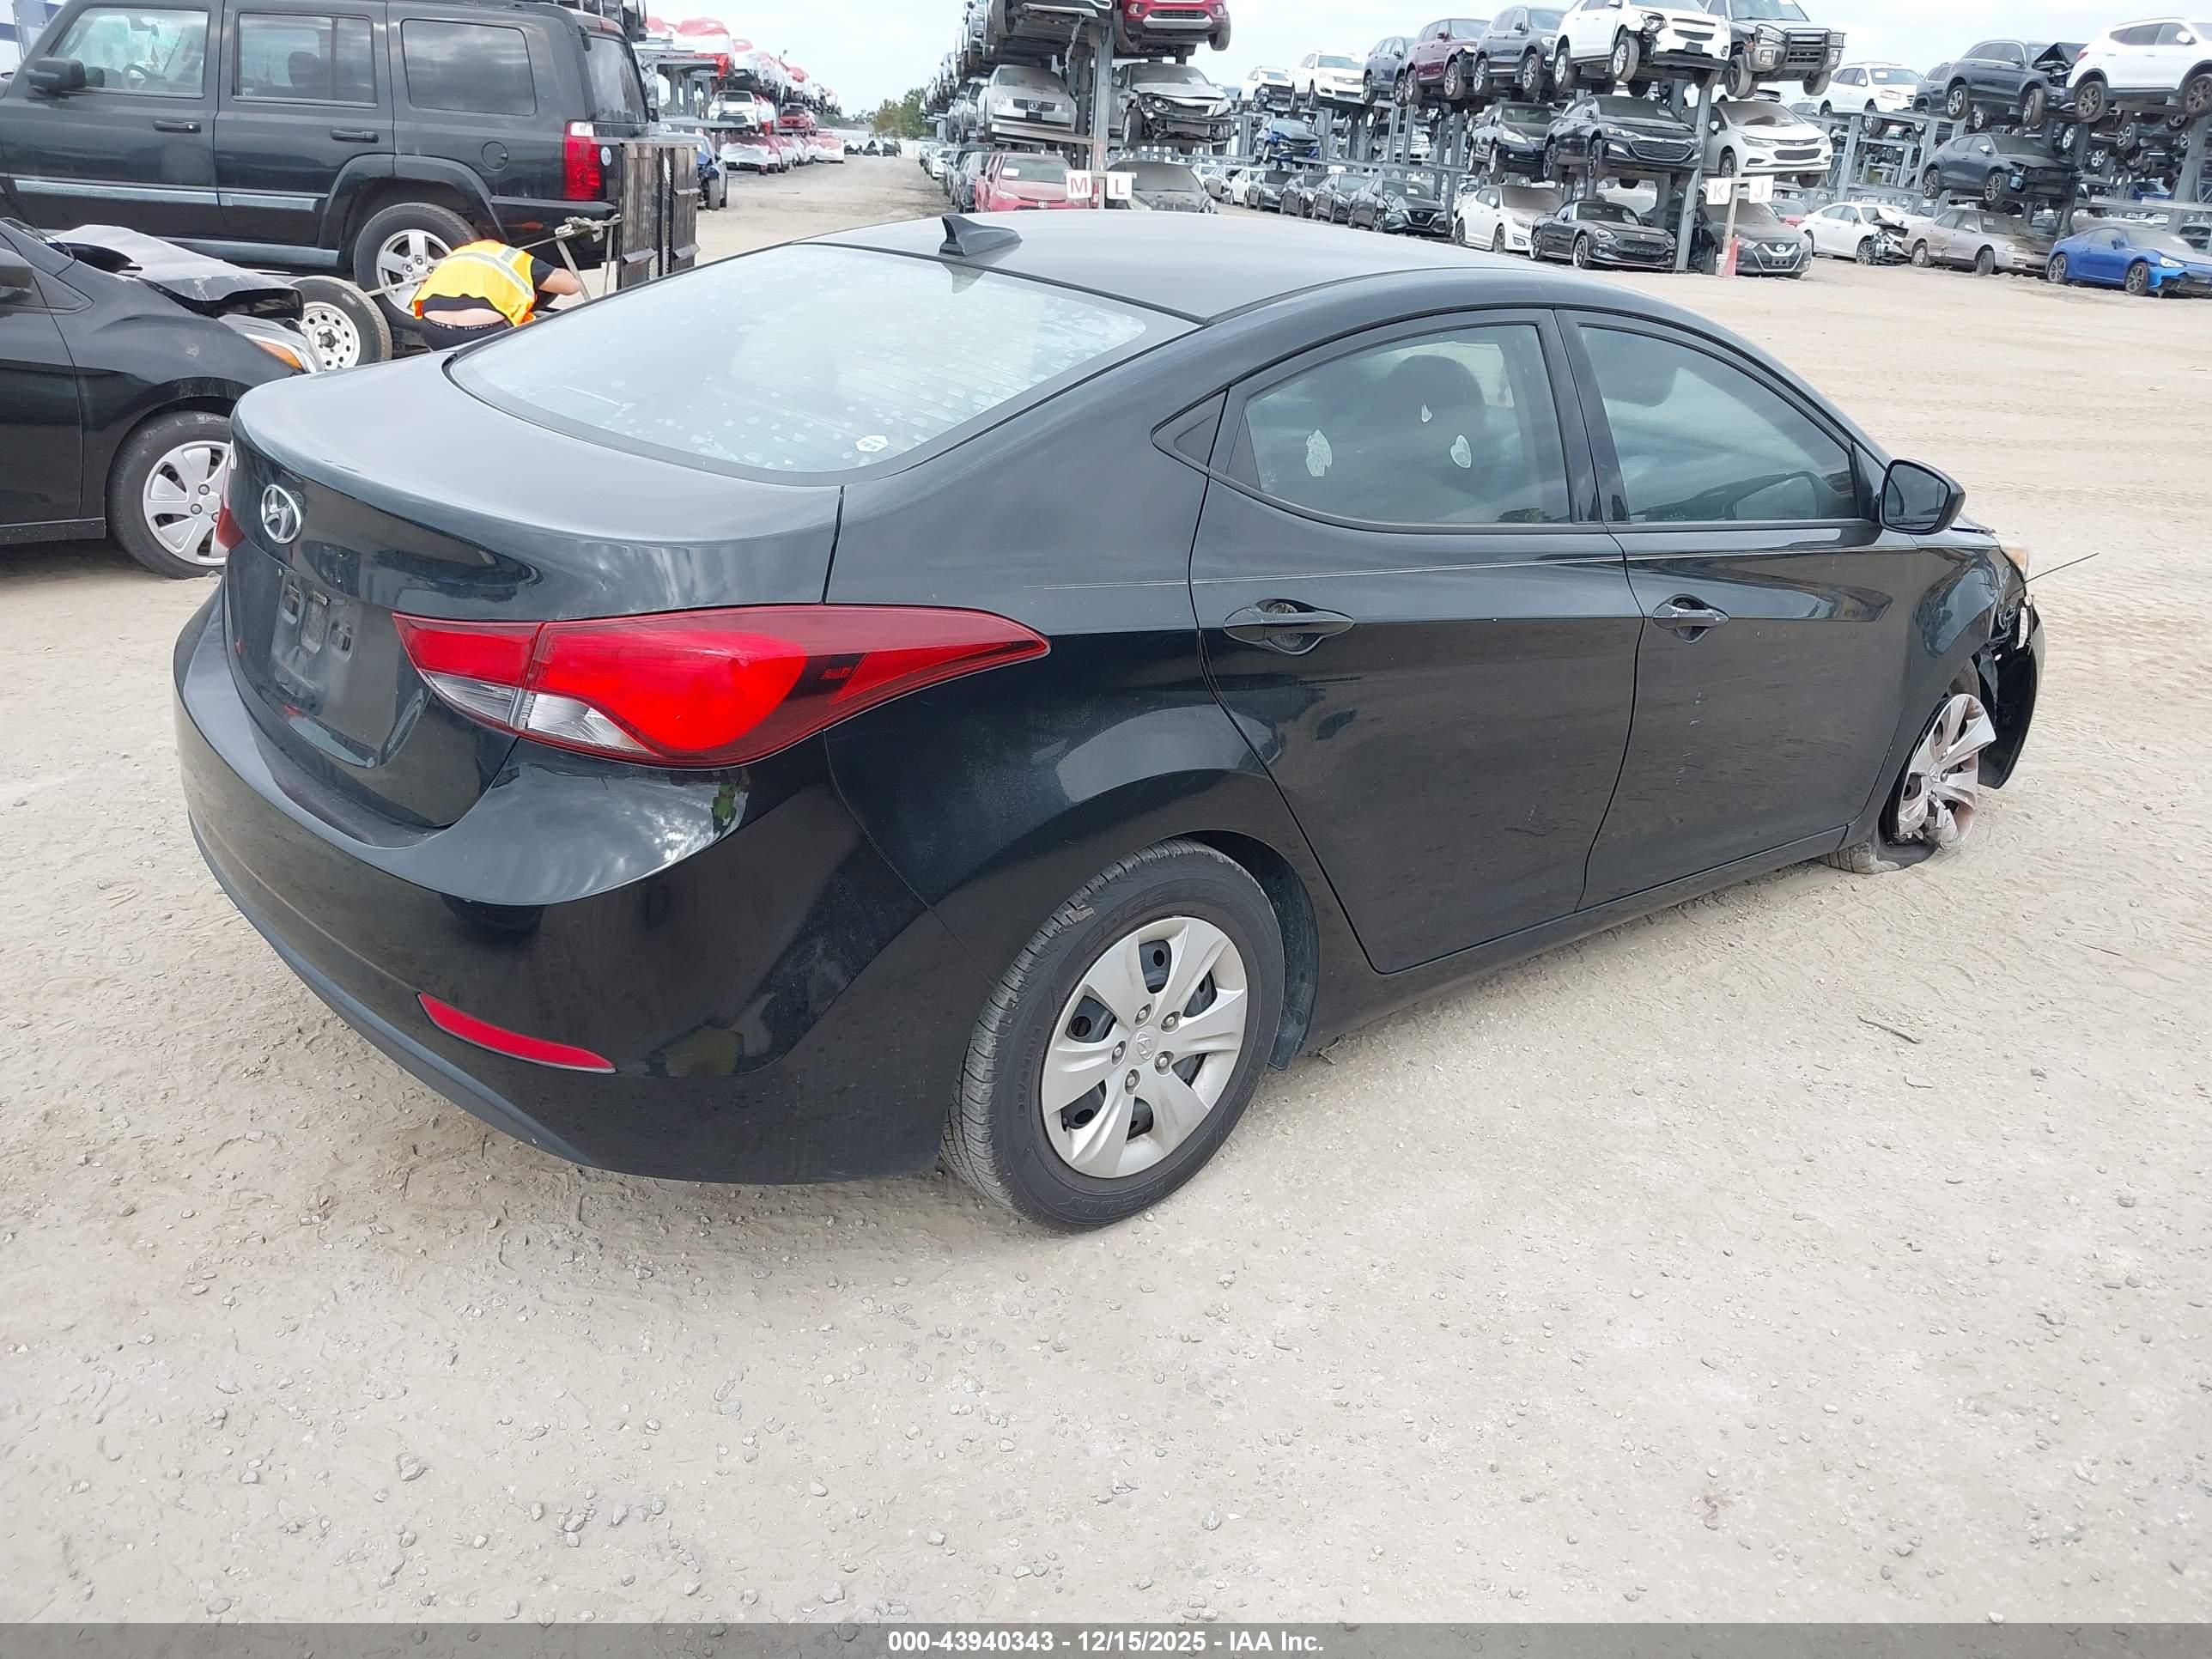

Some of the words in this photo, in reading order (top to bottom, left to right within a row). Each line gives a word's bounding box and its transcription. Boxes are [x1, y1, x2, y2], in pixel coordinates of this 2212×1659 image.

[1070, 177, 1088, 193] M
[1115, 179, 1125, 195] L
[1713, 184, 1724, 199] K
[1754, 182, 1765, 198] J
